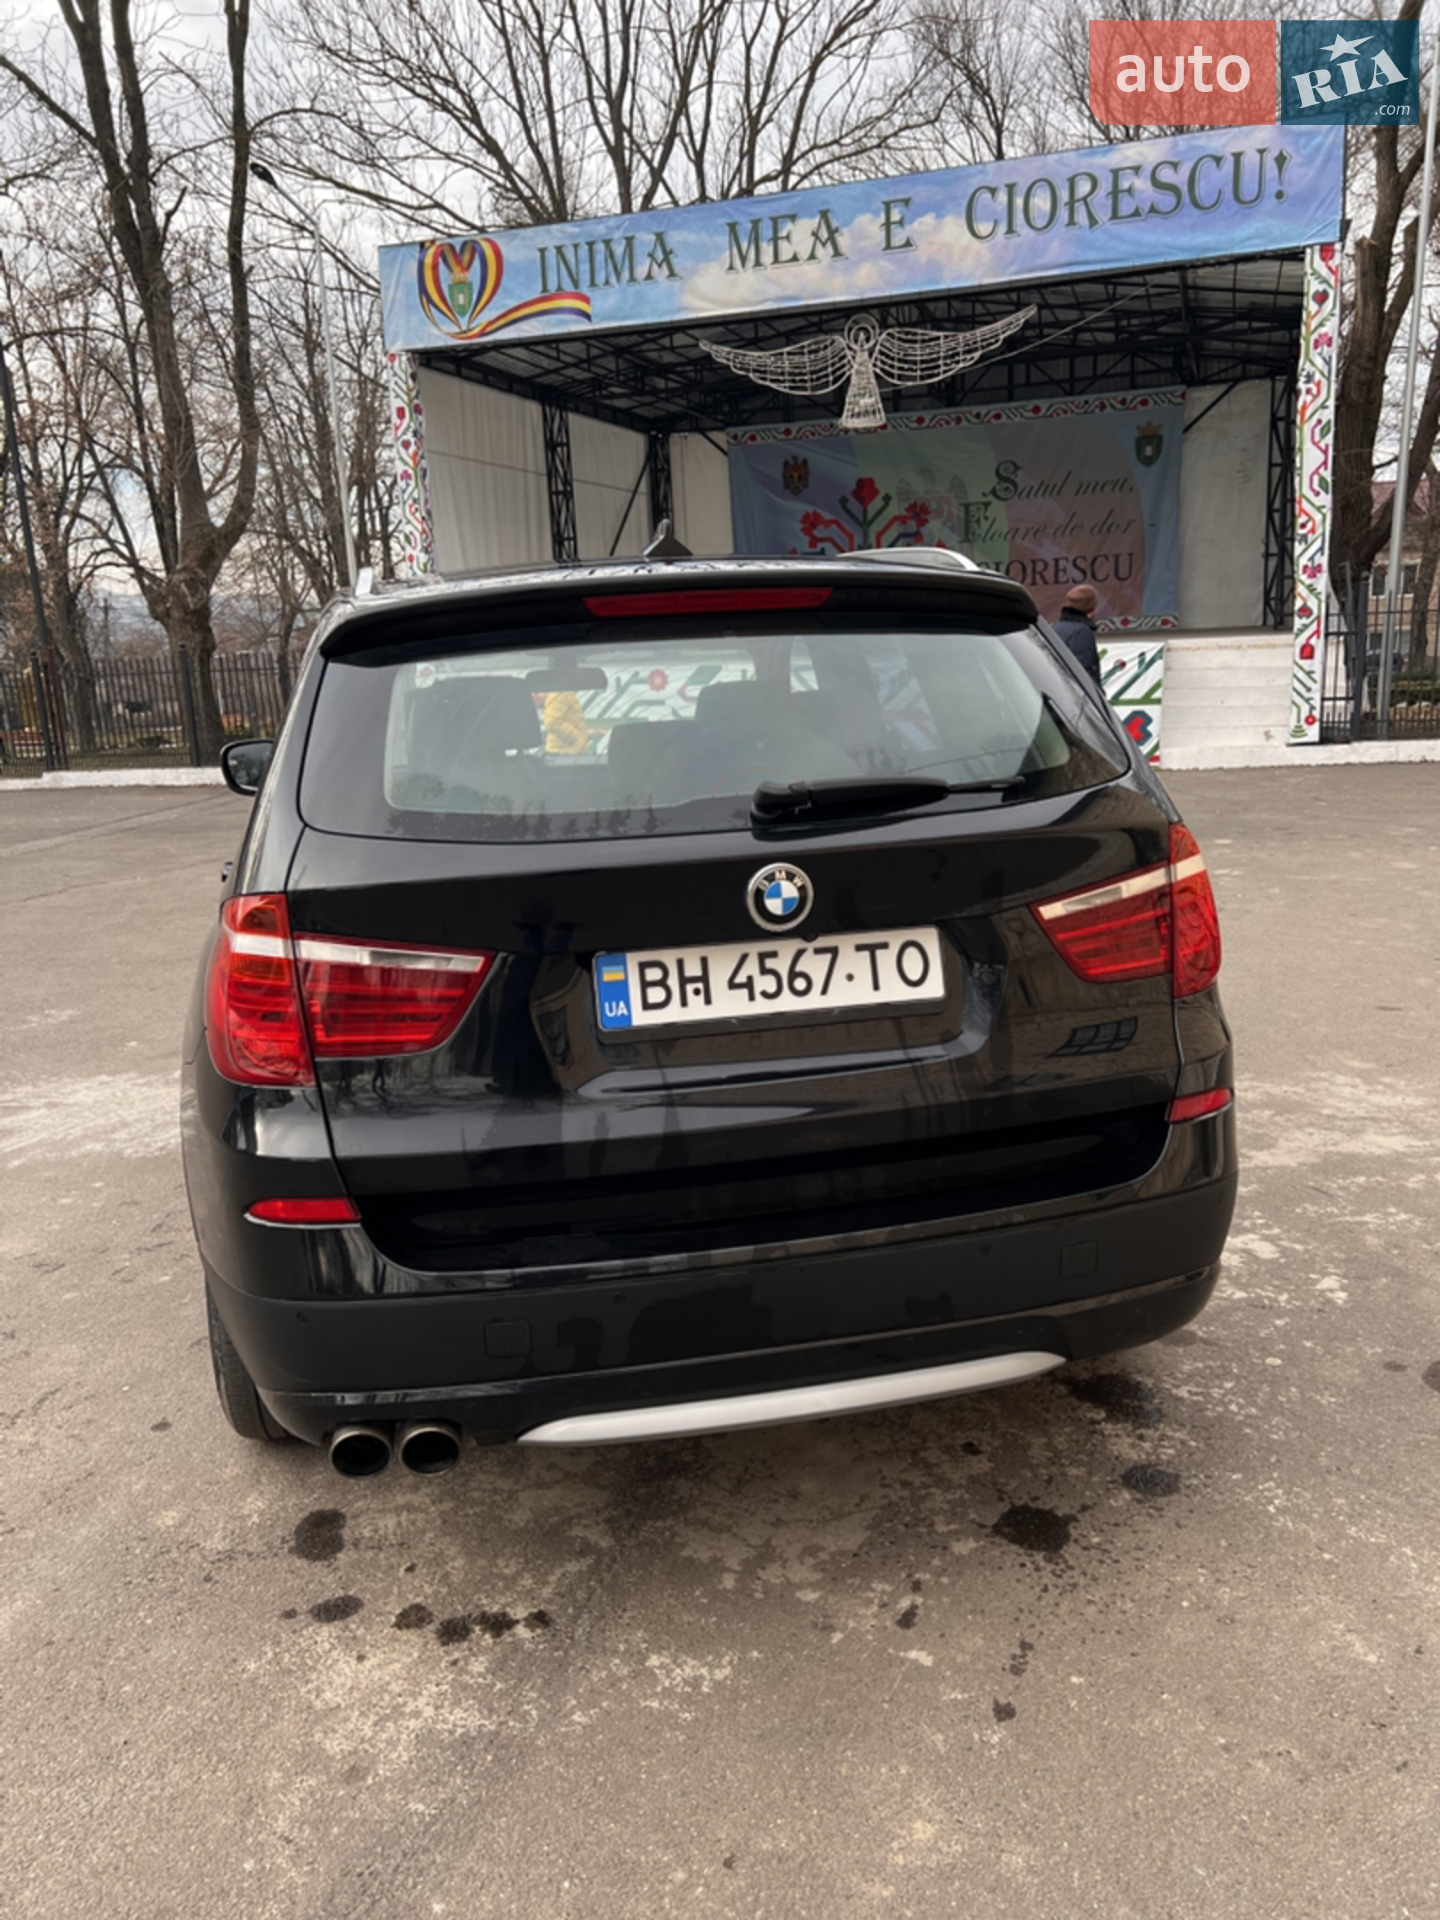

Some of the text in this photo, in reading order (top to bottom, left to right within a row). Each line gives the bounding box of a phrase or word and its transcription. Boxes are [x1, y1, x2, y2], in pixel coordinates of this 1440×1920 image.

[536, 147, 1293, 294] INIMA MEA E CIORESCU!
[981, 459, 1072, 502] Satul
[958, 501, 1138, 545] Floare de dor
[758, 870, 806, 891] BMW
[637, 939, 930, 1012] BH 4567 TO
[605, 1001, 628, 1018] UA
